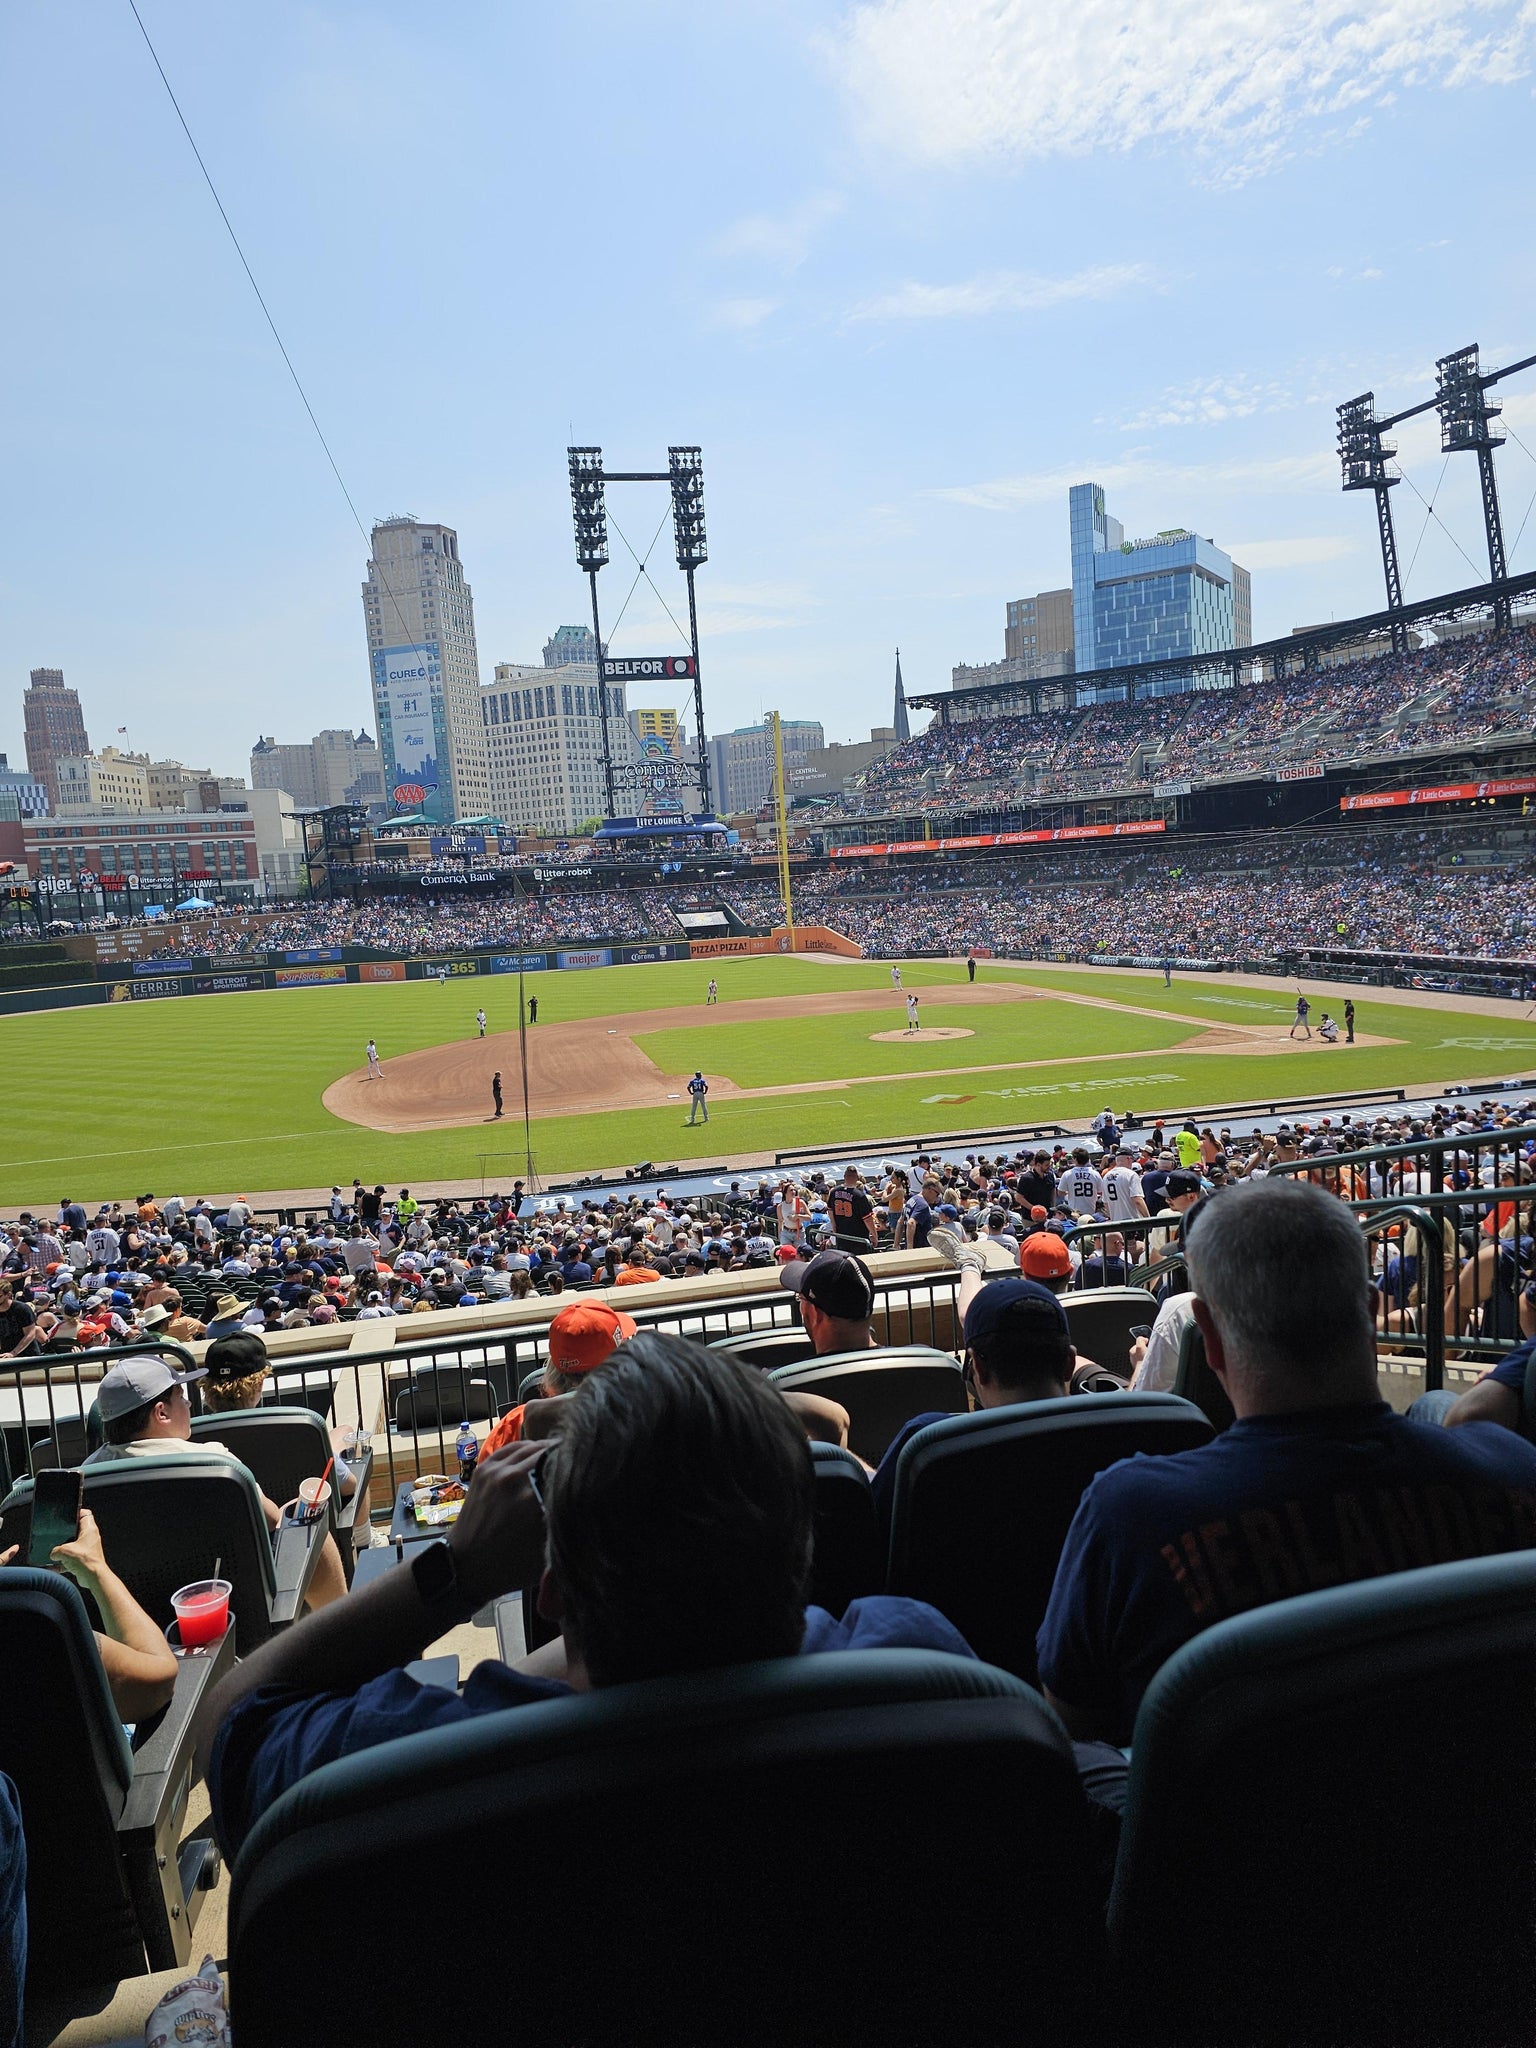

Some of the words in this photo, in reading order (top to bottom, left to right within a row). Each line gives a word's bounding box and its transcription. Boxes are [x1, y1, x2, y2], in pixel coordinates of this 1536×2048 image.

[1134, 531, 1191, 550] Huntington
[389, 668, 417, 679] CURE
[604, 661, 663, 675] BELFOR
[403, 699, 417, 712] #1
[764, 725, 777, 771] Rocket
[1277, 765, 1322, 780] TOSHIBA
[626, 780, 693, 789] LANDING
[1492, 784, 1509, 792] Little
[1510, 782, 1535, 791] Caesars
[398, 786, 424, 803] AAA
[1422, 792, 1438, 800] Little
[1438, 790, 1461, 798] Caesars
[1359, 798, 1374, 806] Little
[1375, 796, 1395, 804] Caesars
[636, 817, 653, 828] Lite
[653, 816, 683, 825] LOUNGE
[1141, 823, 1162, 831] Caesars
[1078, 828, 1098, 836] Caesars
[451, 834, 466, 847] Lite
[100, 875, 126, 883] BELLE
[470, 872, 496, 882] Bank
[38, 876, 72, 894] eijer
[104, 883, 124, 891] TIRE
[193, 879, 213, 888] LAW
[181, 926, 190, 934] 10
[690, 944, 718, 955] PIZZA!
[719, 942, 747, 952] PIZZA!
[805, 940, 824, 949] Little
[508, 956, 541, 966] Mcaren
[568, 952, 600, 966] meijer
[631, 952, 655, 962] Corona
[1048, 953, 1066, 962] bet365
[372, 965, 392, 978] hap
[212, 976, 247, 985] DETROIT
[281, 972, 319, 983] Surfside
[133, 980, 179, 994] FERRIS
[213, 982, 248, 990] SPORTSNET
[979, 1073, 1180, 1096] VICTORS
[1074, 1182, 1093, 1197] 28
[1107, 1183, 1118, 1201] 9
